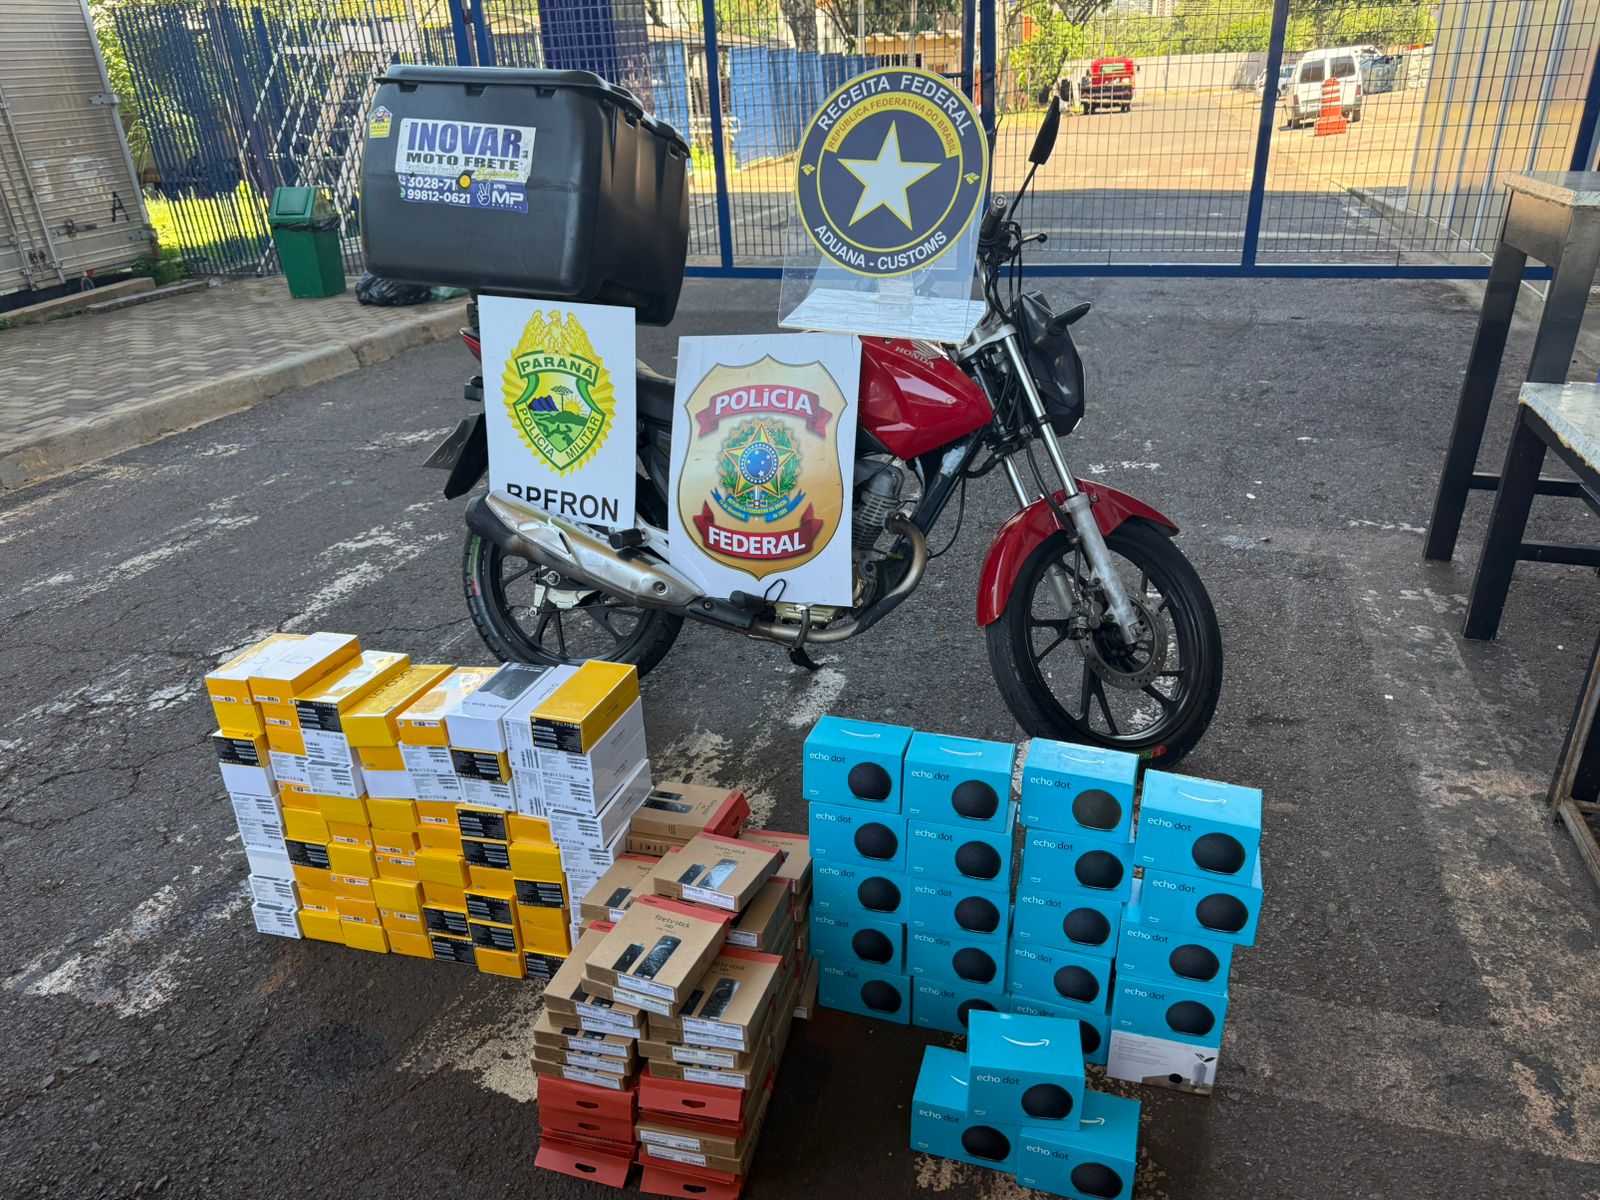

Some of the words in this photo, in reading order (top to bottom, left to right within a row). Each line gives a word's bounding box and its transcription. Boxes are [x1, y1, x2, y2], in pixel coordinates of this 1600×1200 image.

[817, 75, 891, 131] RECEITA
[900, 74, 972, 137] FEDERAL
[870, 97, 927, 114] FEDERATIVA
[925, 108, 938, 123] DO
[936, 120, 956, 155] BRASIL
[407, 122, 522, 159] INOVAR
[406, 152, 459, 166] MOTO
[464, 156, 519, 170] FRETE
[407, 174, 458, 191] 3028-71
[407, 189, 470, 204] 99812-0621
[491, 190, 524, 205] MP
[815, 225, 866, 268] ADUANA
[877, 231, 948, 270] CUSTOMS
[895, 345, 936, 369] HONDA
[519, 355, 595, 379] PARANÁ
[565, 416, 600, 461] MILITAR
[708, 526, 806, 555] FEDERAL
[810, 752, 829, 761] echo
[831, 753, 845, 763] dot
[912, 769, 932, 779] echo
[934, 772, 949, 781] dot
[1030, 777, 1052, 786] echo
[1055, 779, 1071, 789] dot
[816, 812, 836, 821] echo
[837, 814, 852, 823] dot
[1148, 816, 1172, 828] echo
[1175, 820, 1192, 832] dot
[915, 828, 936, 839] echo
[938, 831, 952, 841] dot
[1033, 838, 1056, 849] echo
[1058, 840, 1074, 850] dot
[820, 866, 839, 875] echo
[841, 868, 854, 878] dot
[915, 885, 936, 895] echo
[938, 888, 952, 897] dot
[1153, 878, 1176, 890] echo
[1178, 882, 1196, 893] dot
[1023, 895, 1044, 905] echo
[1046, 898, 1061, 908] dot
[815, 915, 834, 925] echo
[914, 933, 934, 943] echo
[936, 935, 950, 945] dot
[1127, 929, 1150, 940] echo
[1152, 932, 1168, 943] dot
[1015, 949, 1035, 959] echo
[1037, 952, 1052, 963] dot
[825, 966, 843, 976] echo
[920, 985, 939, 995] echo
[941, 988, 955, 998] dot
[1125, 987, 1147, 997] echo
[1149, 989, 1165, 1000] dot
[1017, 1005, 1038, 1015] echo
[977, 1074, 1000, 1083] echo
[1002, 1076, 1020, 1085] dot
[919, 1108, 941, 1119] echo
[943, 1113, 960, 1124] dot
[1026, 1144, 1050, 1155] echo
[1052, 1148, 1069, 1160] dot
